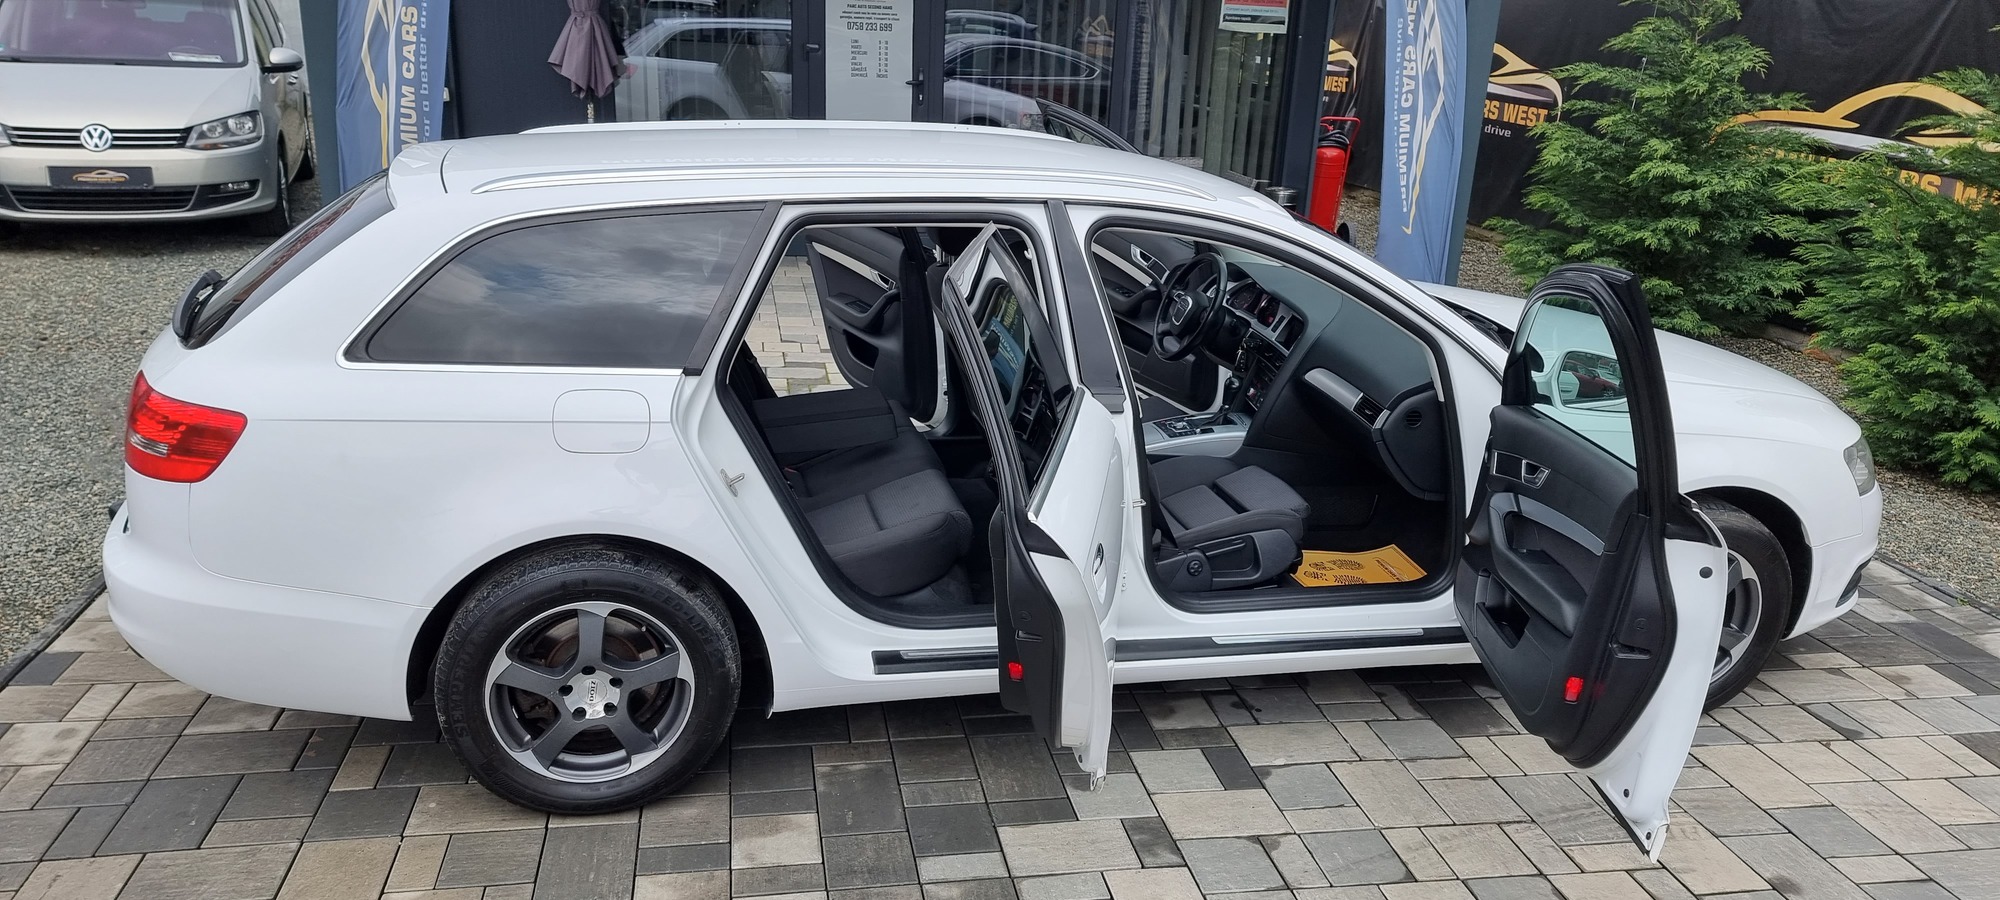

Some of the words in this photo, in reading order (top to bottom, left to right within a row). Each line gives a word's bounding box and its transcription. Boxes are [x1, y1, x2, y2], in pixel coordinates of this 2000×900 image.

[401, 6, 418, 79] CARS
[847, 21, 864, 31] 0758
[865, 22, 878, 31] 233
[879, 23, 893, 32] 699
[419, 34, 429, 94] better
[400, 85, 418, 150] MIUM
[1484, 124, 1512, 137] drive
[1503, 102, 1549, 127] WEST
